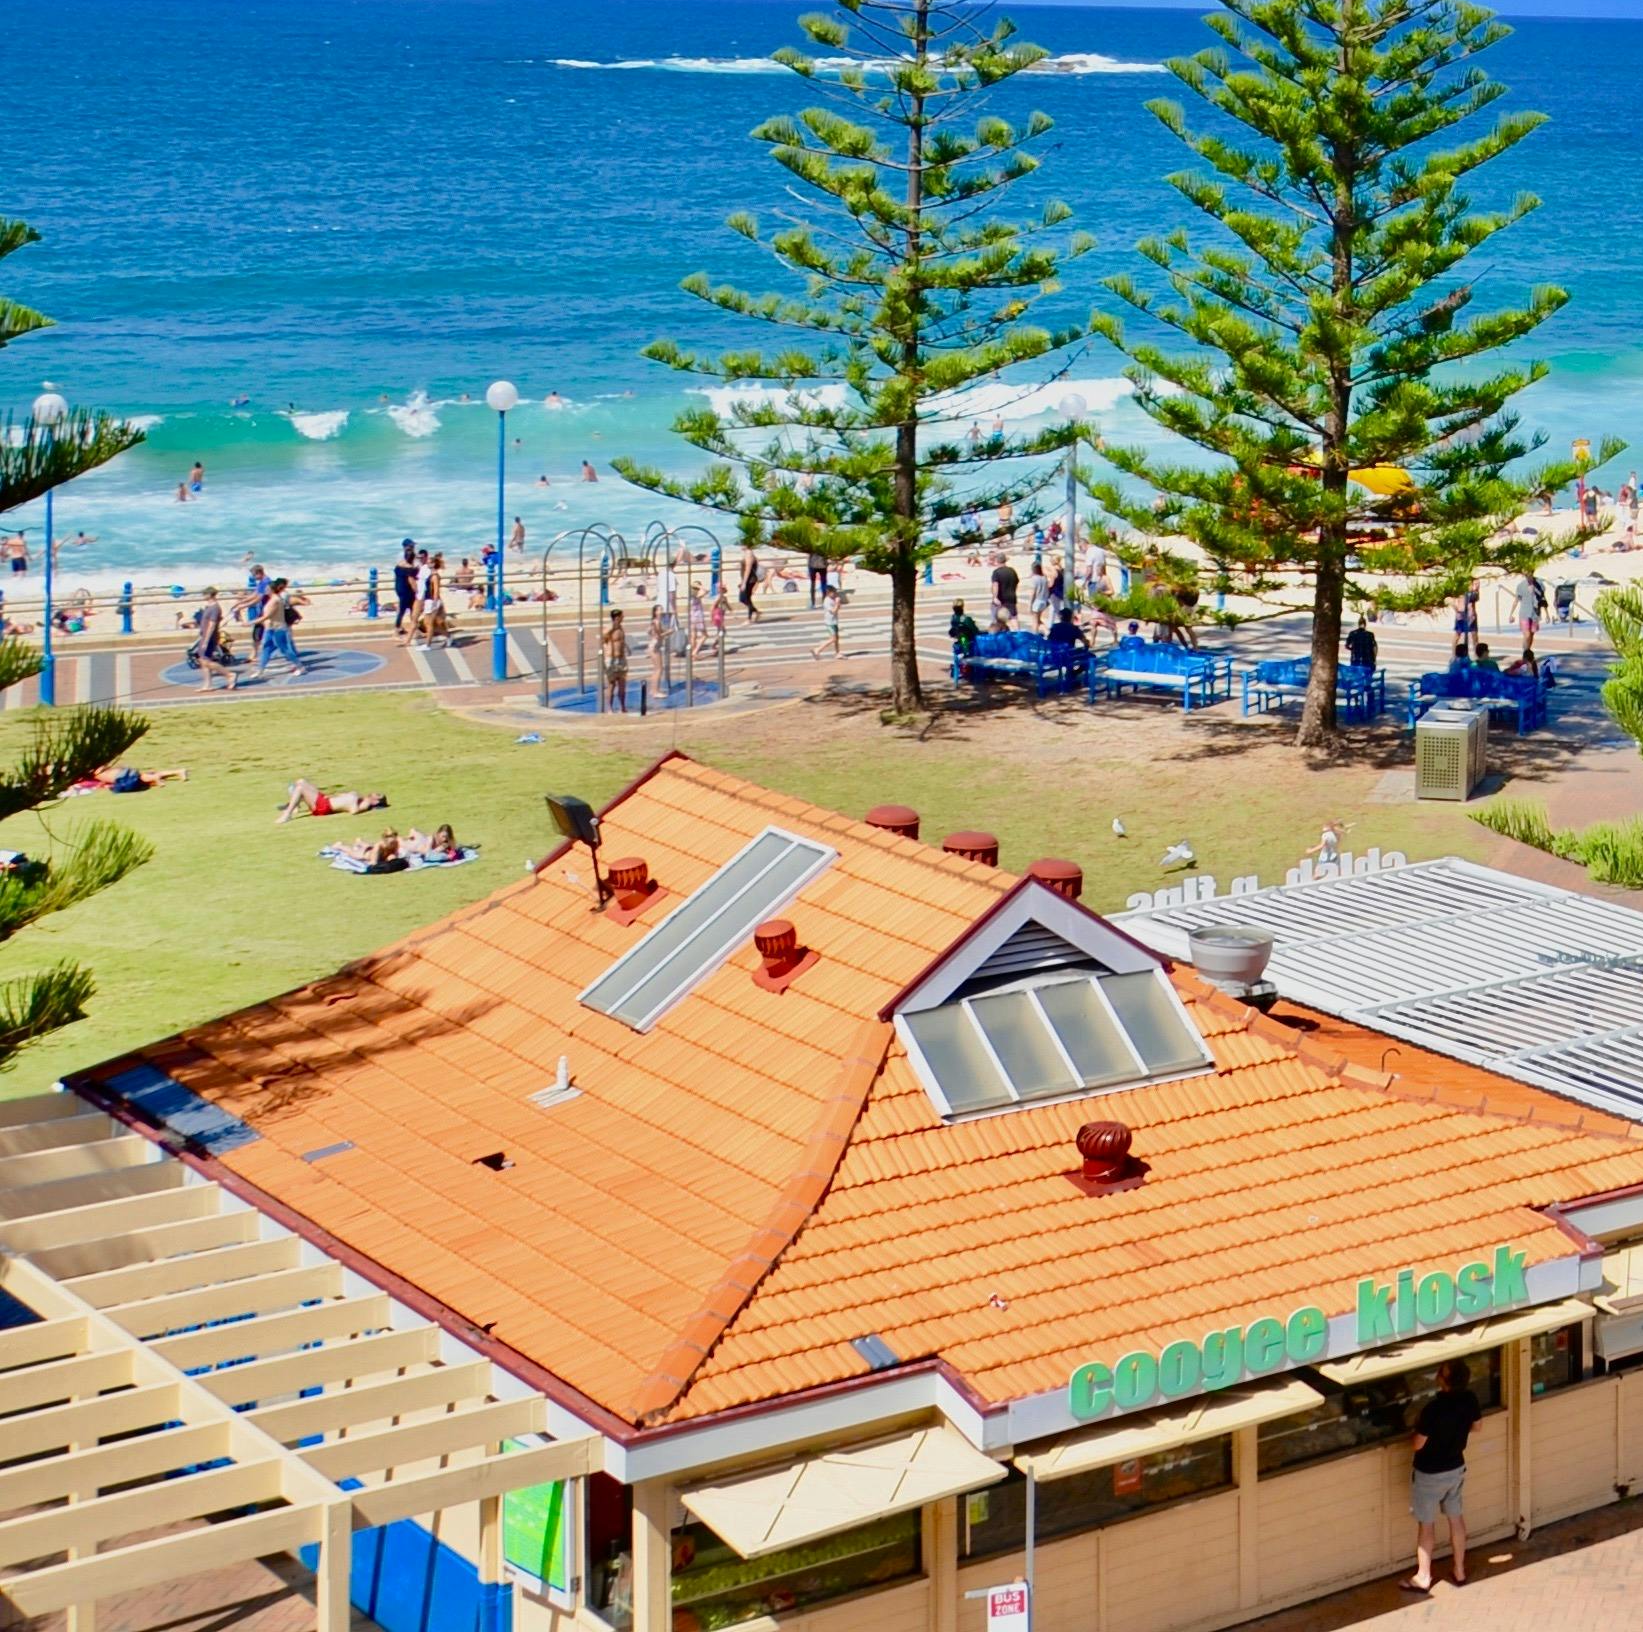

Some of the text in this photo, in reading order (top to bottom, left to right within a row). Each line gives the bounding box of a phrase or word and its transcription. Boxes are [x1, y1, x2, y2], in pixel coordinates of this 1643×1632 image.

[1068, 1244, 1531, 1423] coogee kiosk
[994, 1591, 1021, 1605] BUS
[995, 1602, 1021, 1617] ZONE
